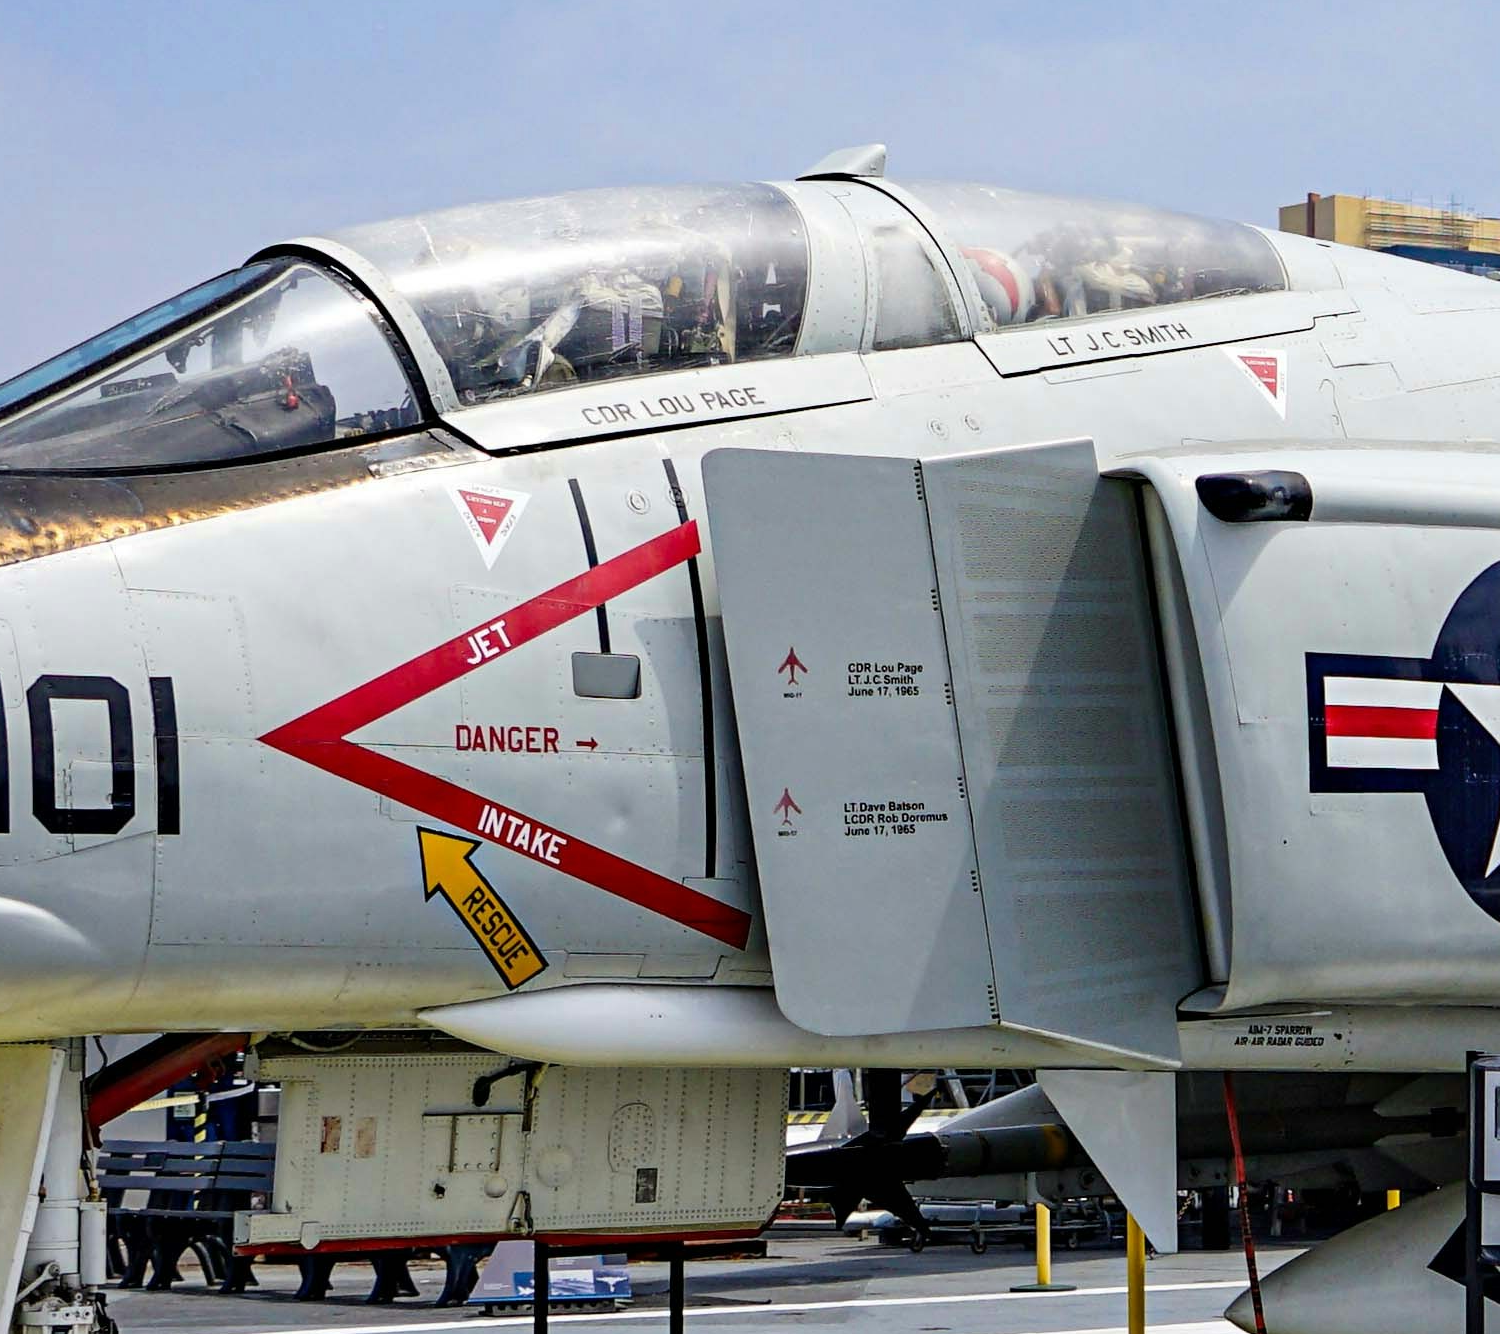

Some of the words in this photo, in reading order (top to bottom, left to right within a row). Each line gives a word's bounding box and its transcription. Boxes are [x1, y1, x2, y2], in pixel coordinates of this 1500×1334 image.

[1049, 336, 1080, 357] LT
[1126, 322, 1194, 347] SMITH
[582, 401, 633, 425] CDR
[647, 394, 695, 416] LOU
[701, 386, 766, 411] PAGE
[466, 618, 513, 666] JET
[848, 663, 871, 673] CDR
[875, 663, 894, 673] Lou
[897, 663, 924, 675] Page
[883, 675, 914, 685] Smith
[848, 687, 874, 697] June
[878, 687, 892, 698] 17,
[896, 687, 919, 696] 1965
[455, 726, 560, 754] DANGER
[860, 802, 886, 812] Dave
[888, 801, 925, 811] Batson
[844, 814, 874, 824] LCDR
[878, 813, 899, 823] Rob
[902, 812, 948, 823] Doremus
[477, 804, 567, 865] INTAKE
[844, 825, 870, 836] June
[874, 825, 888, 837] 17,
[892, 824, 916, 834] 1965
[462, 886, 529, 970] RESCUE
[1274, 1025, 1313, 1035] SPARROW
